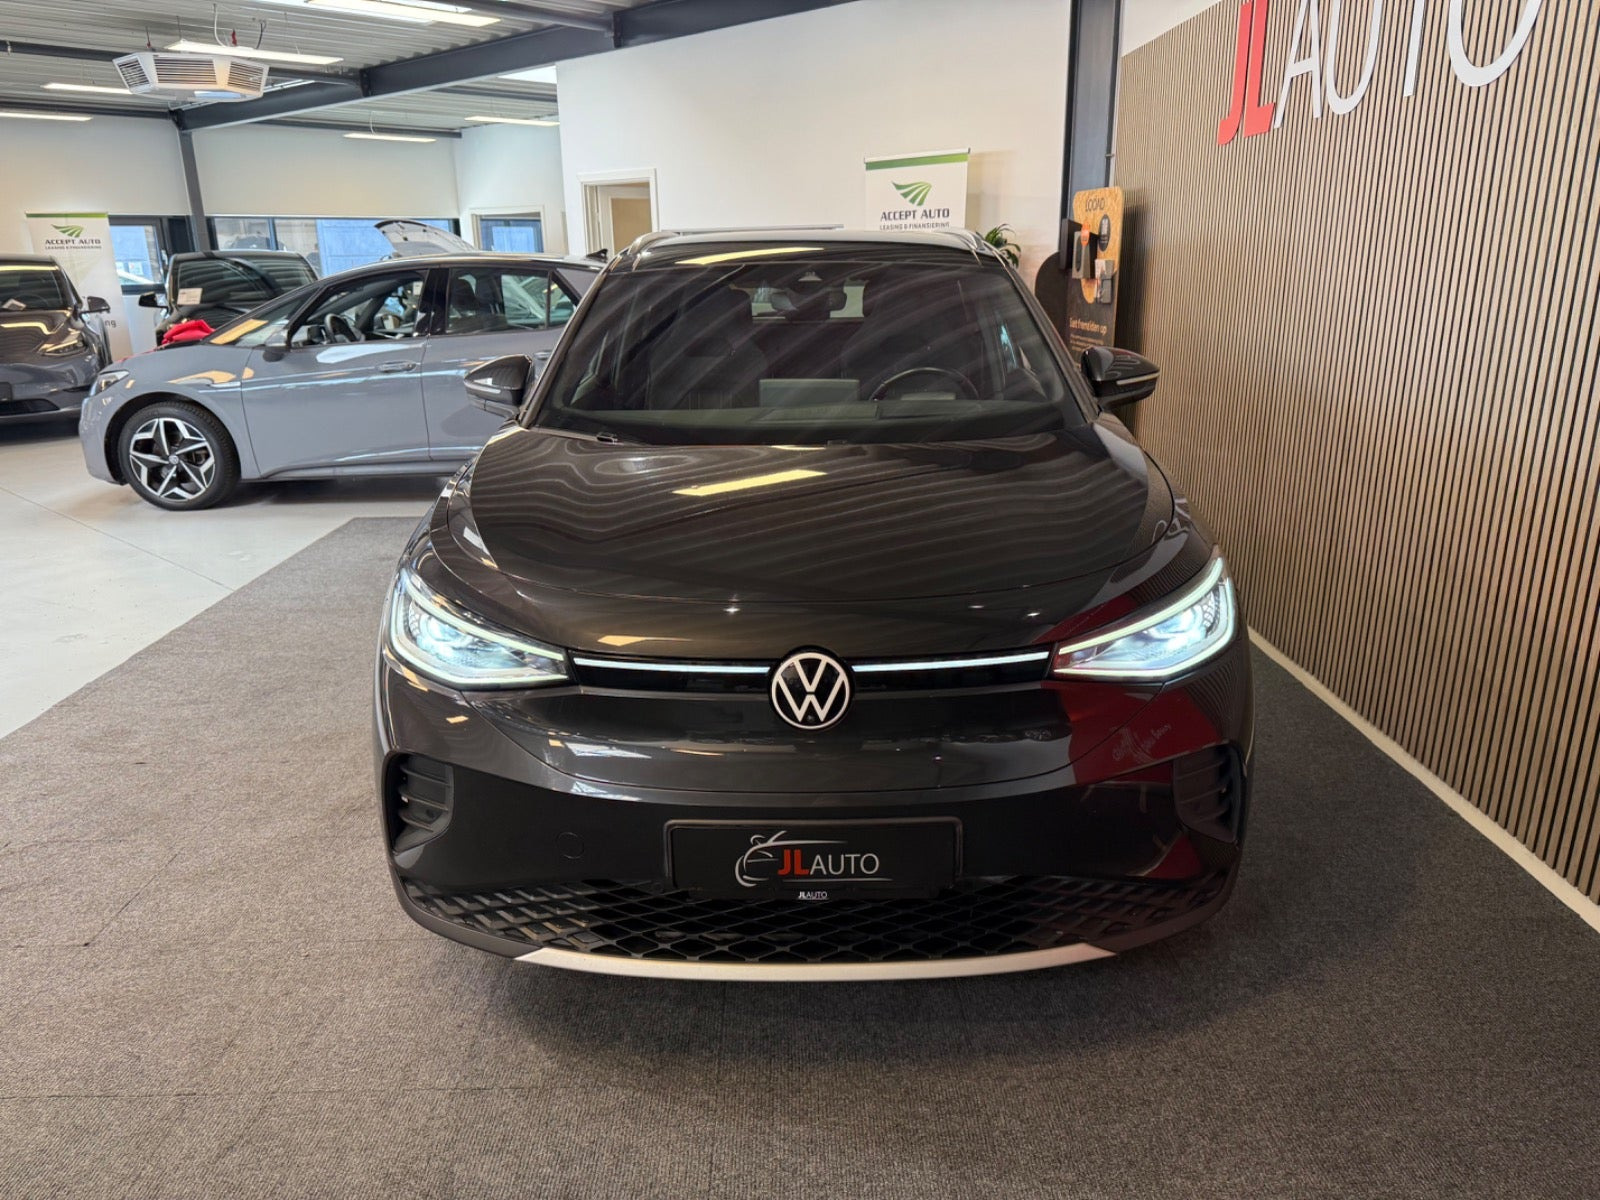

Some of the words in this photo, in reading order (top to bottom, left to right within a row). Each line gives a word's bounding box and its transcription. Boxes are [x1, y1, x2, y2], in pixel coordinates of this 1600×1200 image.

[880, 210, 918, 221] ACCEPT
[920, 208, 950, 219] AUTO
[880, 223, 903, 231] LEASING
[777, 849, 880, 875] JLAUTO
